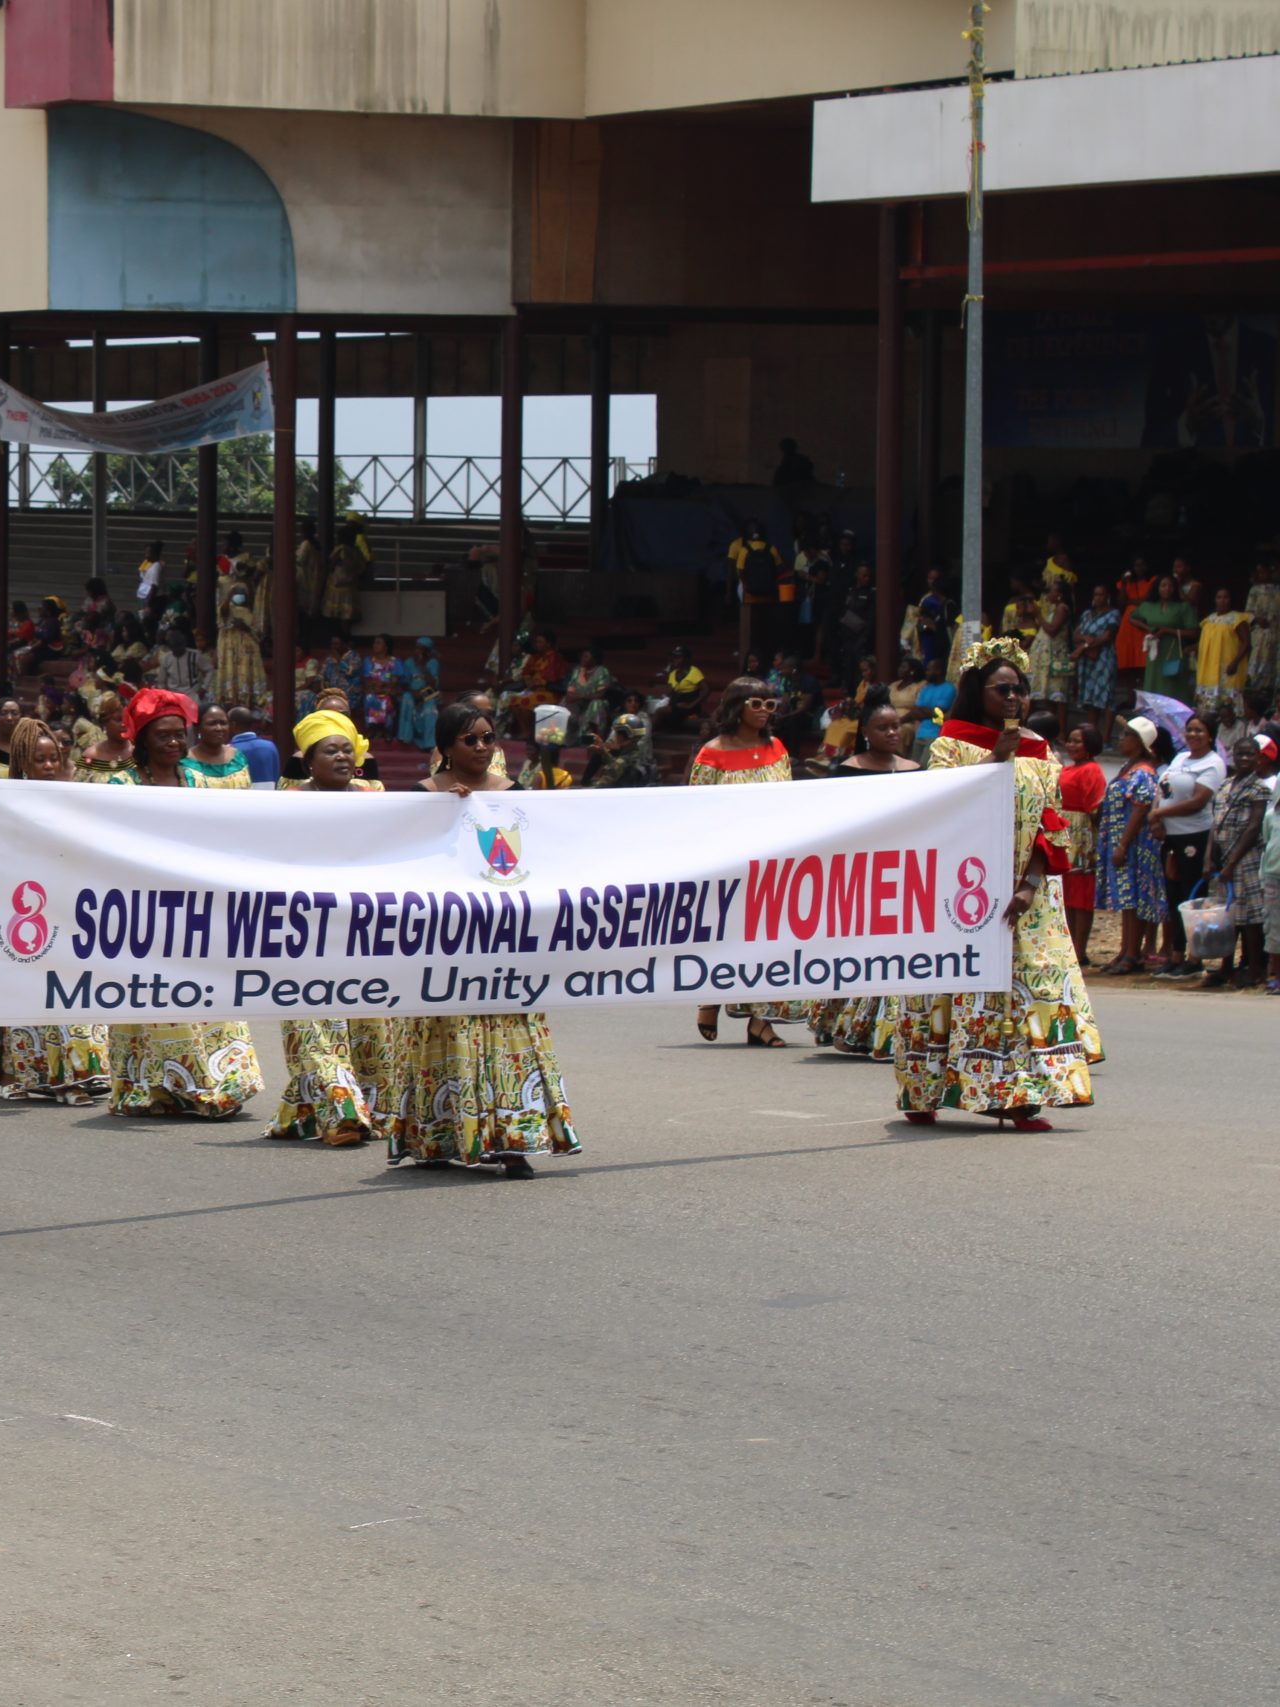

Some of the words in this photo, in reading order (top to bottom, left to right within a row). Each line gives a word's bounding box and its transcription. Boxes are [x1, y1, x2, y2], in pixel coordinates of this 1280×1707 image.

[72, 888, 214, 960] SOUTH
[227, 890, 337, 959] WEST
[346, 890, 539, 957] REGIONAL
[548, 877, 741, 952] ASSEMBLY
[744, 848, 937, 942] WOMEN
[45, 970, 215, 1010] Motto:
[233, 969, 400, 1008] Peace,
[421, 966, 549, 1007] Unity
[564, 956, 656, 996] and
[673, 943, 980, 991] Development
